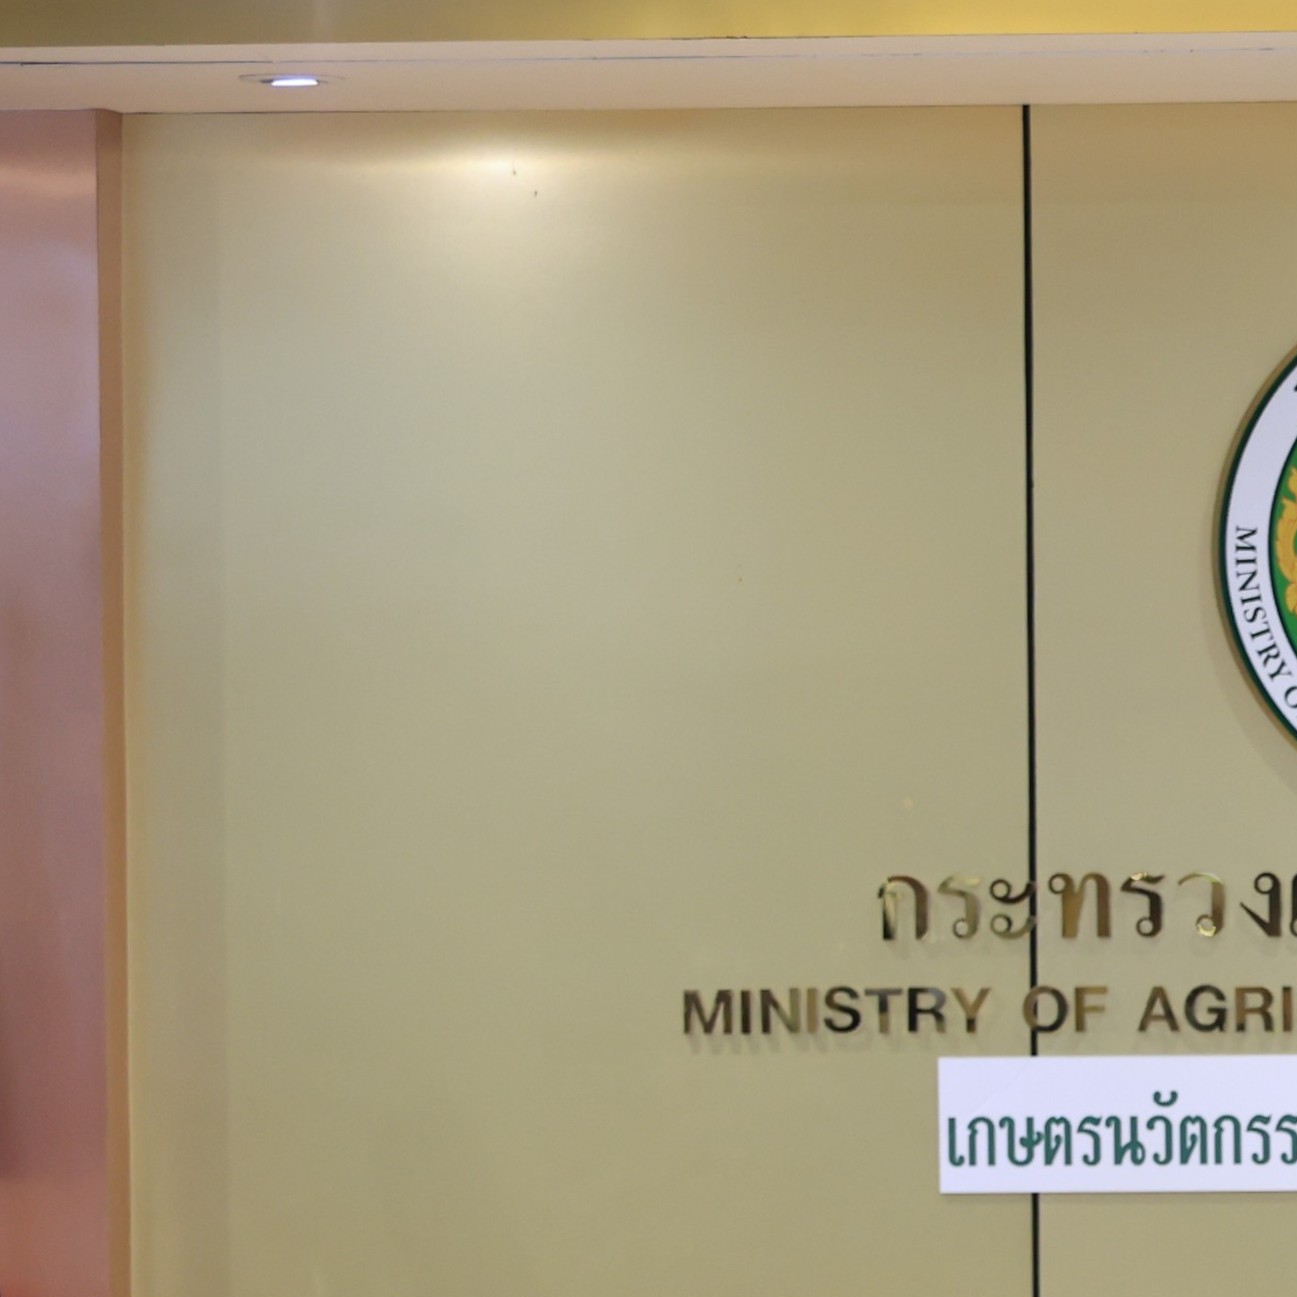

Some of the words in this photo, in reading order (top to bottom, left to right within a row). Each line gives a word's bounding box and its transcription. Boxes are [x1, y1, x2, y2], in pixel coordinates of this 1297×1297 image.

[1234, 525, 1294, 681] MINISTRY
[682, 985, 991, 1036] MINISTRY
[1022, 985, 1108, 1033] OF
